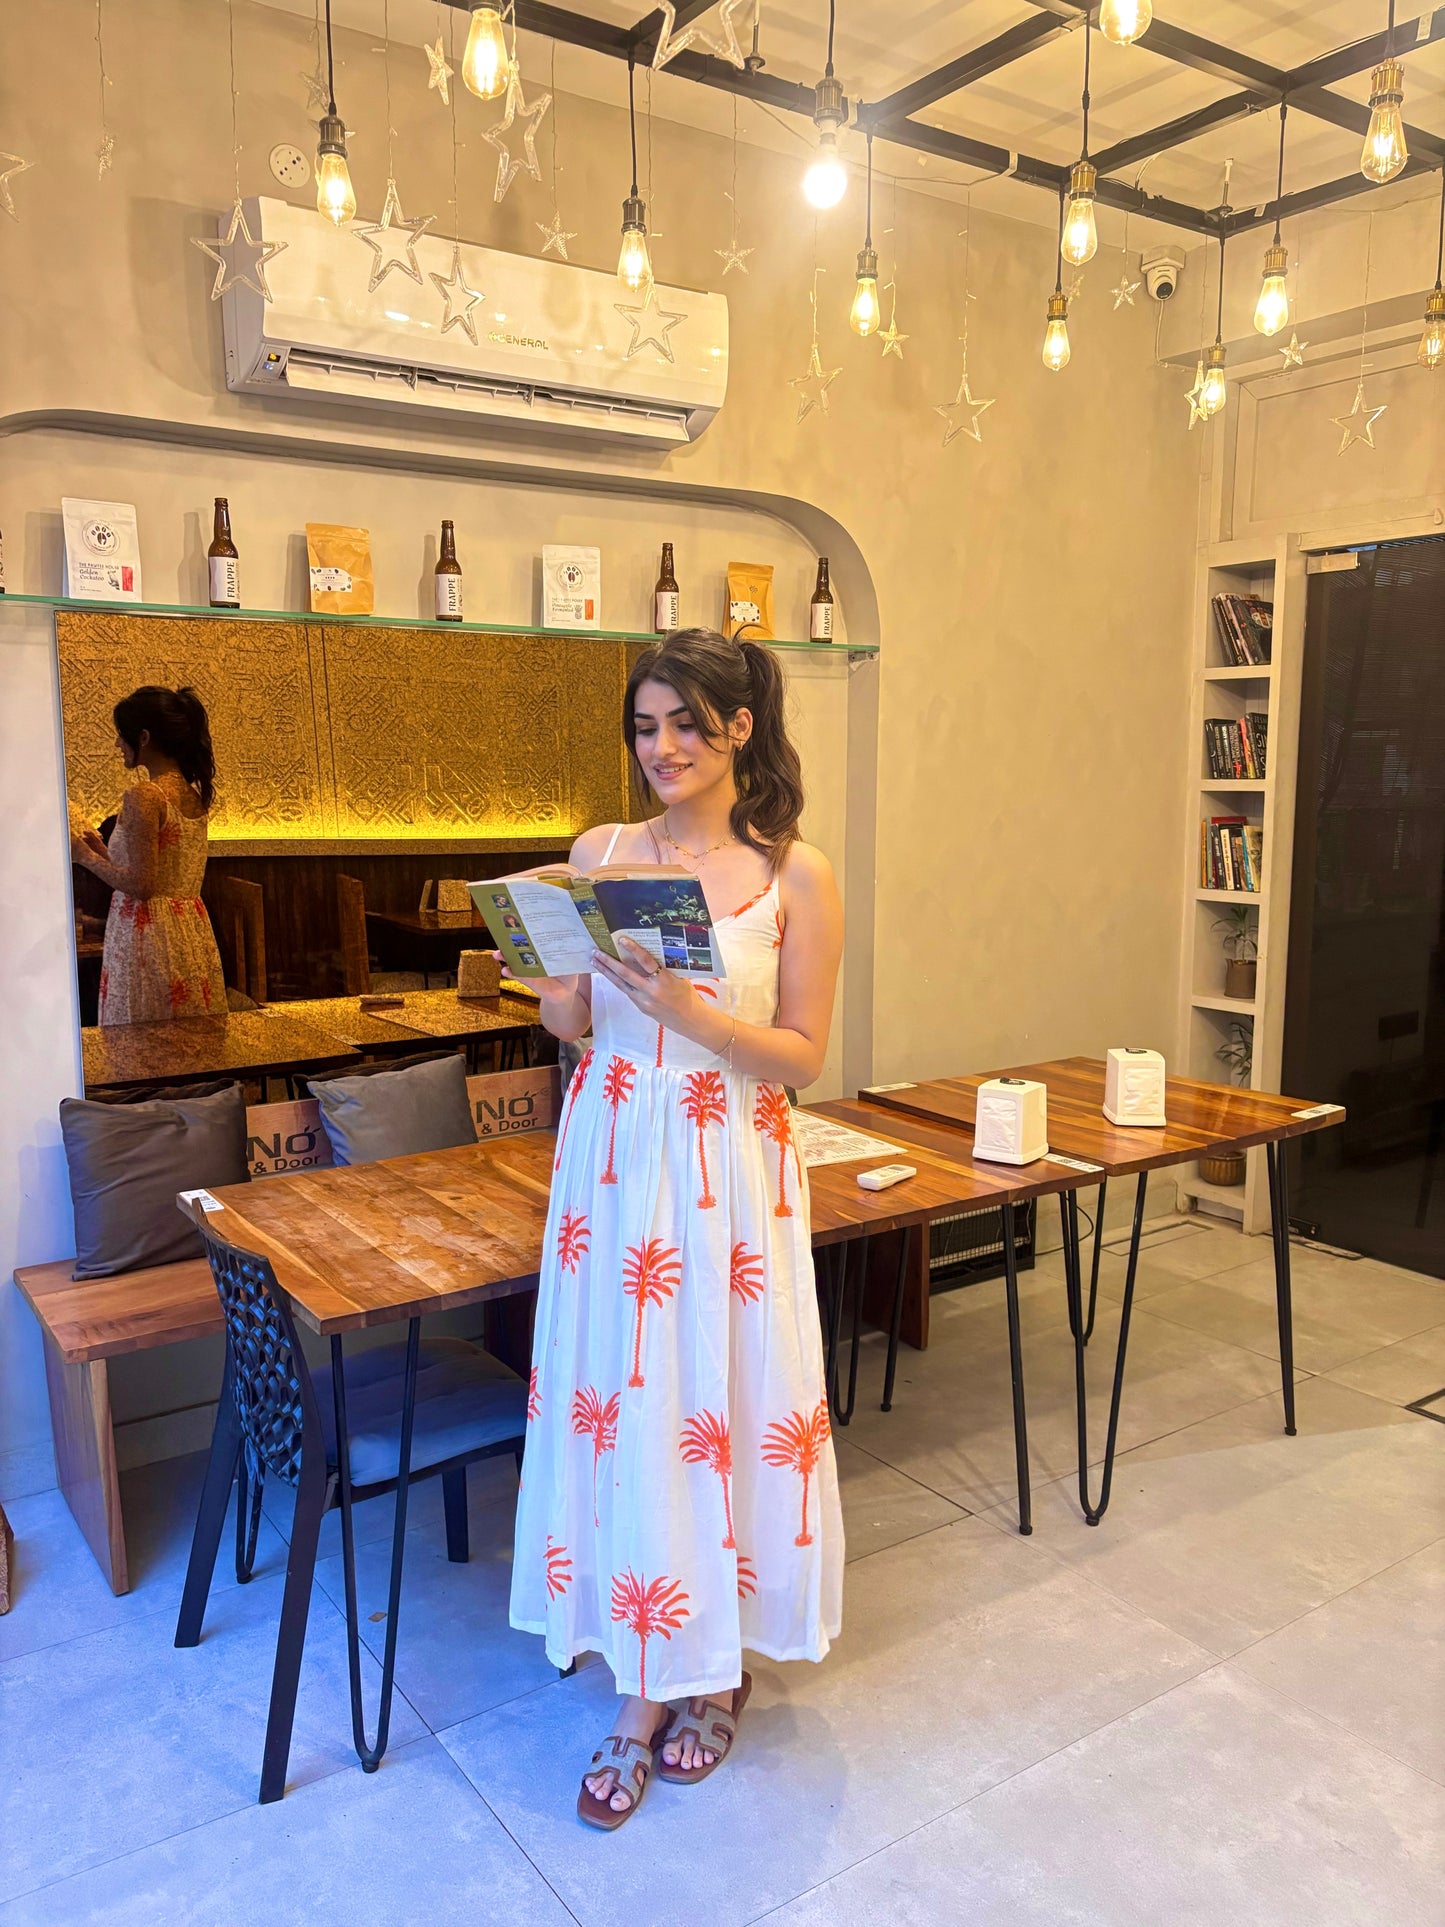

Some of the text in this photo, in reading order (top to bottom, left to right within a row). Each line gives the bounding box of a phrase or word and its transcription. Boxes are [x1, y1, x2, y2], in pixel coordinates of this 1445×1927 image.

[227, 561, 235, 598] FRAPPE
[448, 577, 456, 612] FRAPPE
[481, 1117, 538, 1135] & Door
[253, 1156, 321, 1174] & Door
